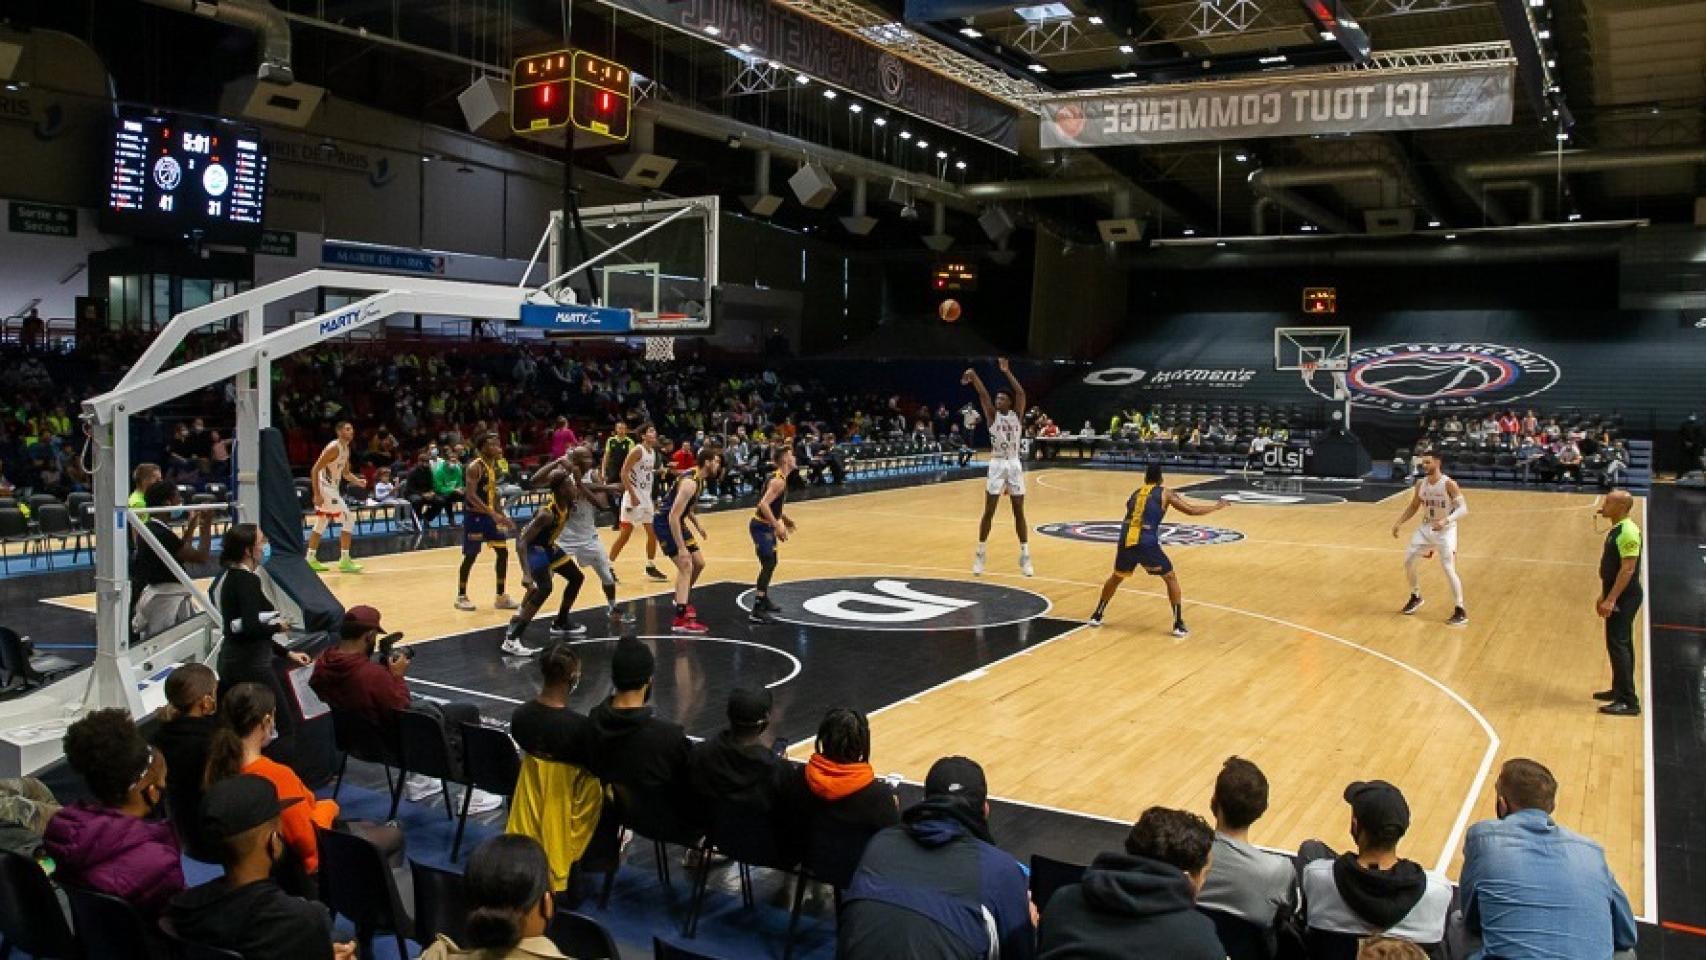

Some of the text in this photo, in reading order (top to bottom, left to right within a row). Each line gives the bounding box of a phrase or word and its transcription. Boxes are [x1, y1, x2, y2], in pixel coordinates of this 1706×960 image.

[183, 131, 210, 154] 5:01
[158, 194, 174, 212] 41
[207, 200, 222, 217] 31
[320, 310, 361, 336] MARTY
[556, 312, 588, 323] MARTY
[1265, 446, 1304, 468] dlsi
